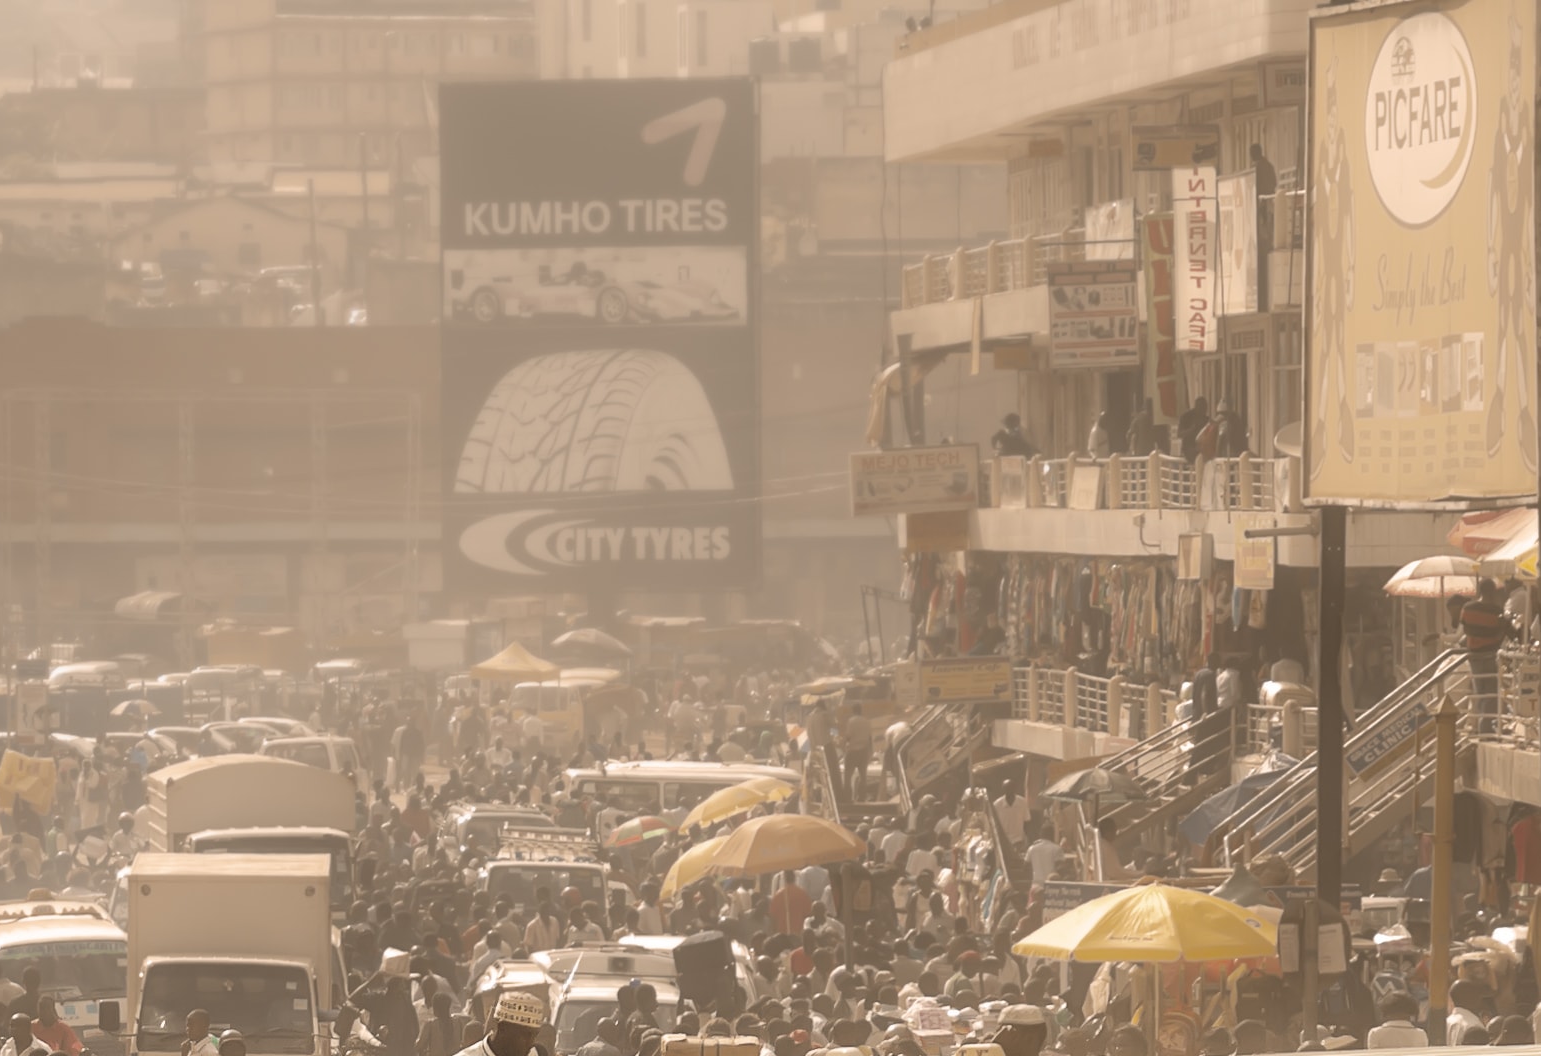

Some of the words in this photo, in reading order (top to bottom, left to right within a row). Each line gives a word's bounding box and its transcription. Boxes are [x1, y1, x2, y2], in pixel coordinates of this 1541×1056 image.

[1375, 77, 1461, 150] PICFARE
[464, 200, 611, 236] KUMHO
[618, 198, 729, 233] TIRES
[1372, 251, 1417, 327] Simply
[1419, 251, 1436, 307] the
[1439, 245, 1467, 306] Best
[860, 454, 910, 471] MEJO
[914, 450, 961, 468] TECH
[556, 527, 626, 561] CITY
[631, 526, 732, 560] TYRES
[1363, 724, 1413, 763] CLINIC
